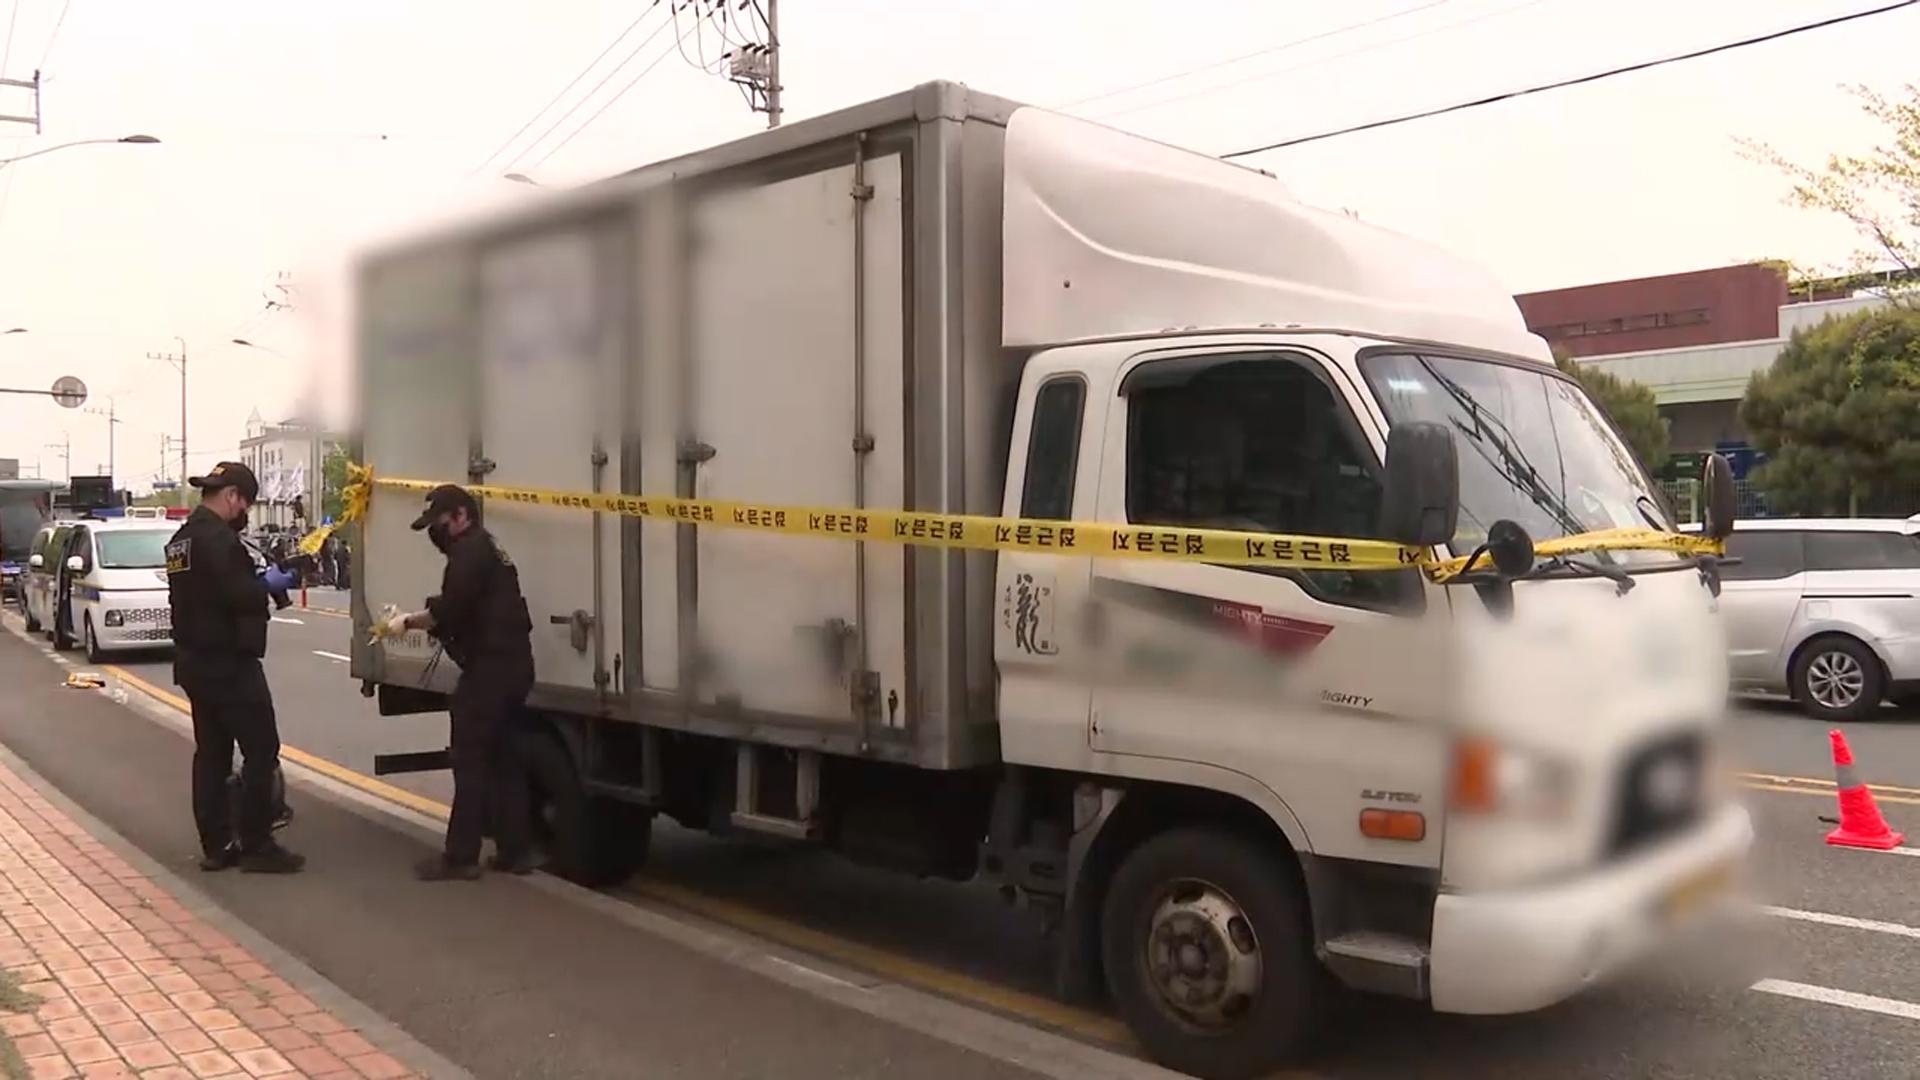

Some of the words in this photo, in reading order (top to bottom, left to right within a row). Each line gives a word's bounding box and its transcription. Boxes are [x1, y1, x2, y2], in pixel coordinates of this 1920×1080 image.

[666, 504, 714, 521] 접근금지
[733, 508, 786, 528] 접근금지
[809, 512, 868, 534] 접근금지
[894, 517, 964, 540] 접근금지
[995, 522, 1075, 548] 접근금지
[1112, 529, 1204, 556] 접근금지
[1245, 537, 1352, 563] 접근금지
